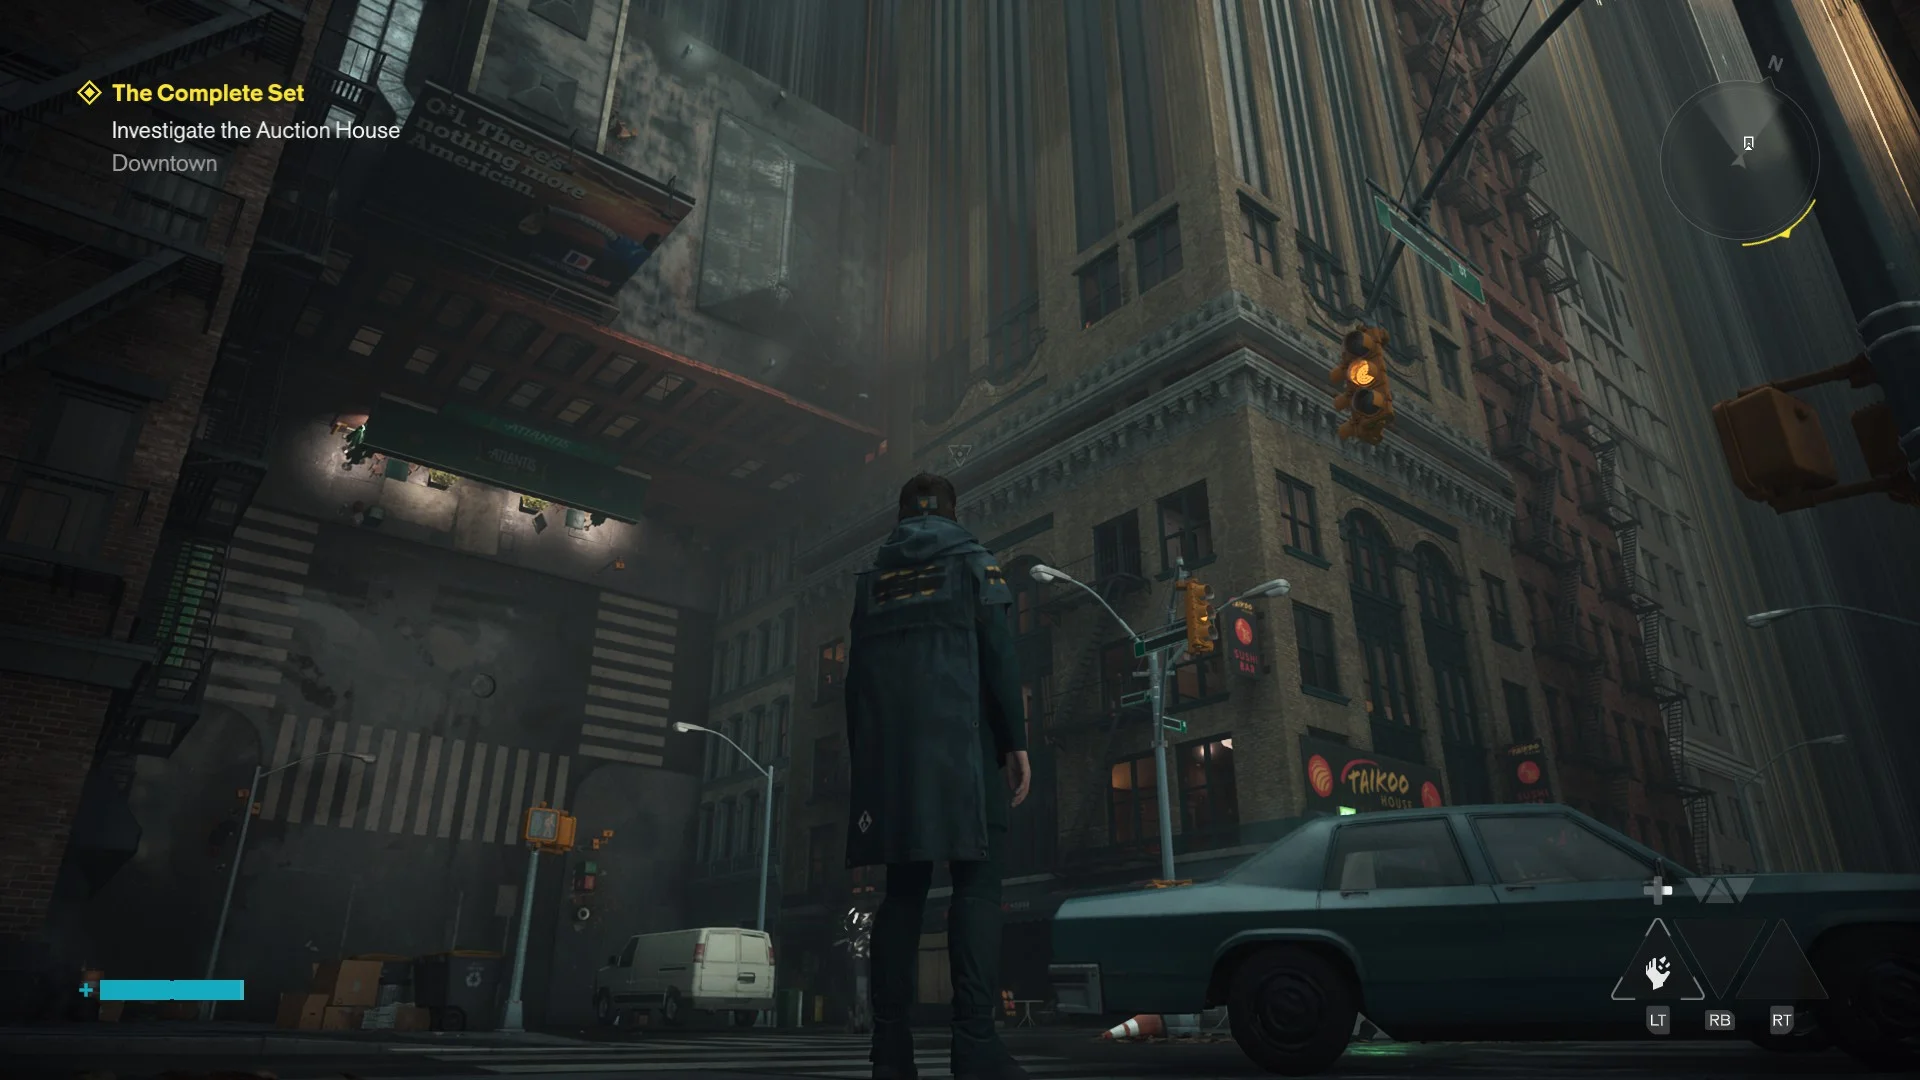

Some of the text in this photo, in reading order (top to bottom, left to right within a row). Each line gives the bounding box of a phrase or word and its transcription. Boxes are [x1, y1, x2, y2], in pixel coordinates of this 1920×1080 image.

[425, 97, 564, 172] Oil. There's
[408, 132, 536, 198] American.
[415, 116, 587, 200] nothing more
[504, 422, 571, 449] ATLANTIS
[488, 447, 537, 472] ATLANTIS
[1233, 648, 1258, 664] SUSHI
[1239, 661, 1255, 674] BAR
[1348, 767, 1410, 795] TAIKOO
[1380, 795, 1413, 809] HOUSE
